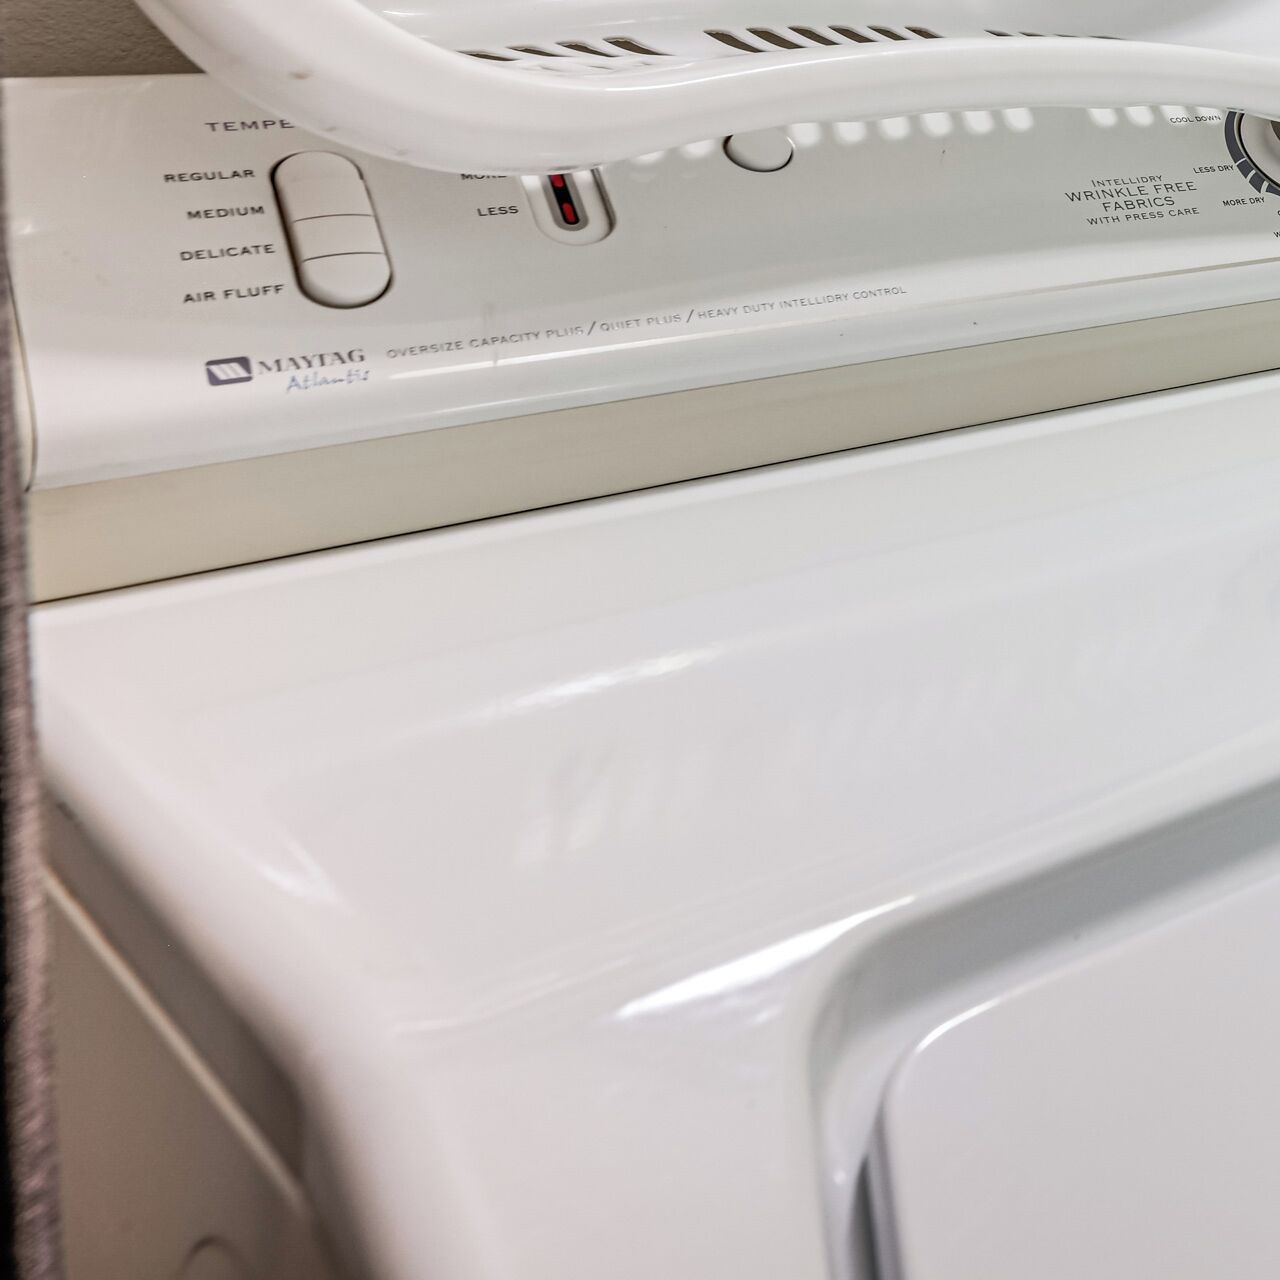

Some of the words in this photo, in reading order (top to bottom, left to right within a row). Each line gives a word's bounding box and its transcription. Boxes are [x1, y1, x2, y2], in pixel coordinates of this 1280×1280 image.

[1195, 115, 1221, 123] DOWN
[164, 169, 256, 182] REGULAR
[1193, 166, 1216, 174] LESS
[1218, 164, 1235, 172] DRY
[1065, 185, 1149, 202] WRINKLE
[1154, 181, 1198, 194] FREE
[477, 205, 519, 217] LESS
[1102, 196, 1175, 212] FABRICS
[1222, 199, 1248, 207] MORE
[187, 205, 265, 220] MEDIUM
[1086, 215, 1121, 225] WITH
[1125, 211, 1164, 222] PRESS
[1169, 207, 1200, 217] CARE
[179, 244, 276, 261] DELICATE
[183, 291, 216, 304] AIR
[223, 284, 284, 299] FLUFF
[386, 341, 464, 359] OVERSIZE
[469, 331, 541, 348] CAPACITY
[545, 325, 584, 339] PLUS
[600, 318, 641, 332] QUIET
[647, 313, 682, 326] PLUS
[697, 306, 738, 320] HEAVY
[743, 302, 775, 314] DUTY
[779, 293, 849, 309] INTELLIDRY
[852, 286, 907, 300] CONTROL
[258, 348, 365, 374] MAYTAG
[287, 370, 370, 392] Atlantis
